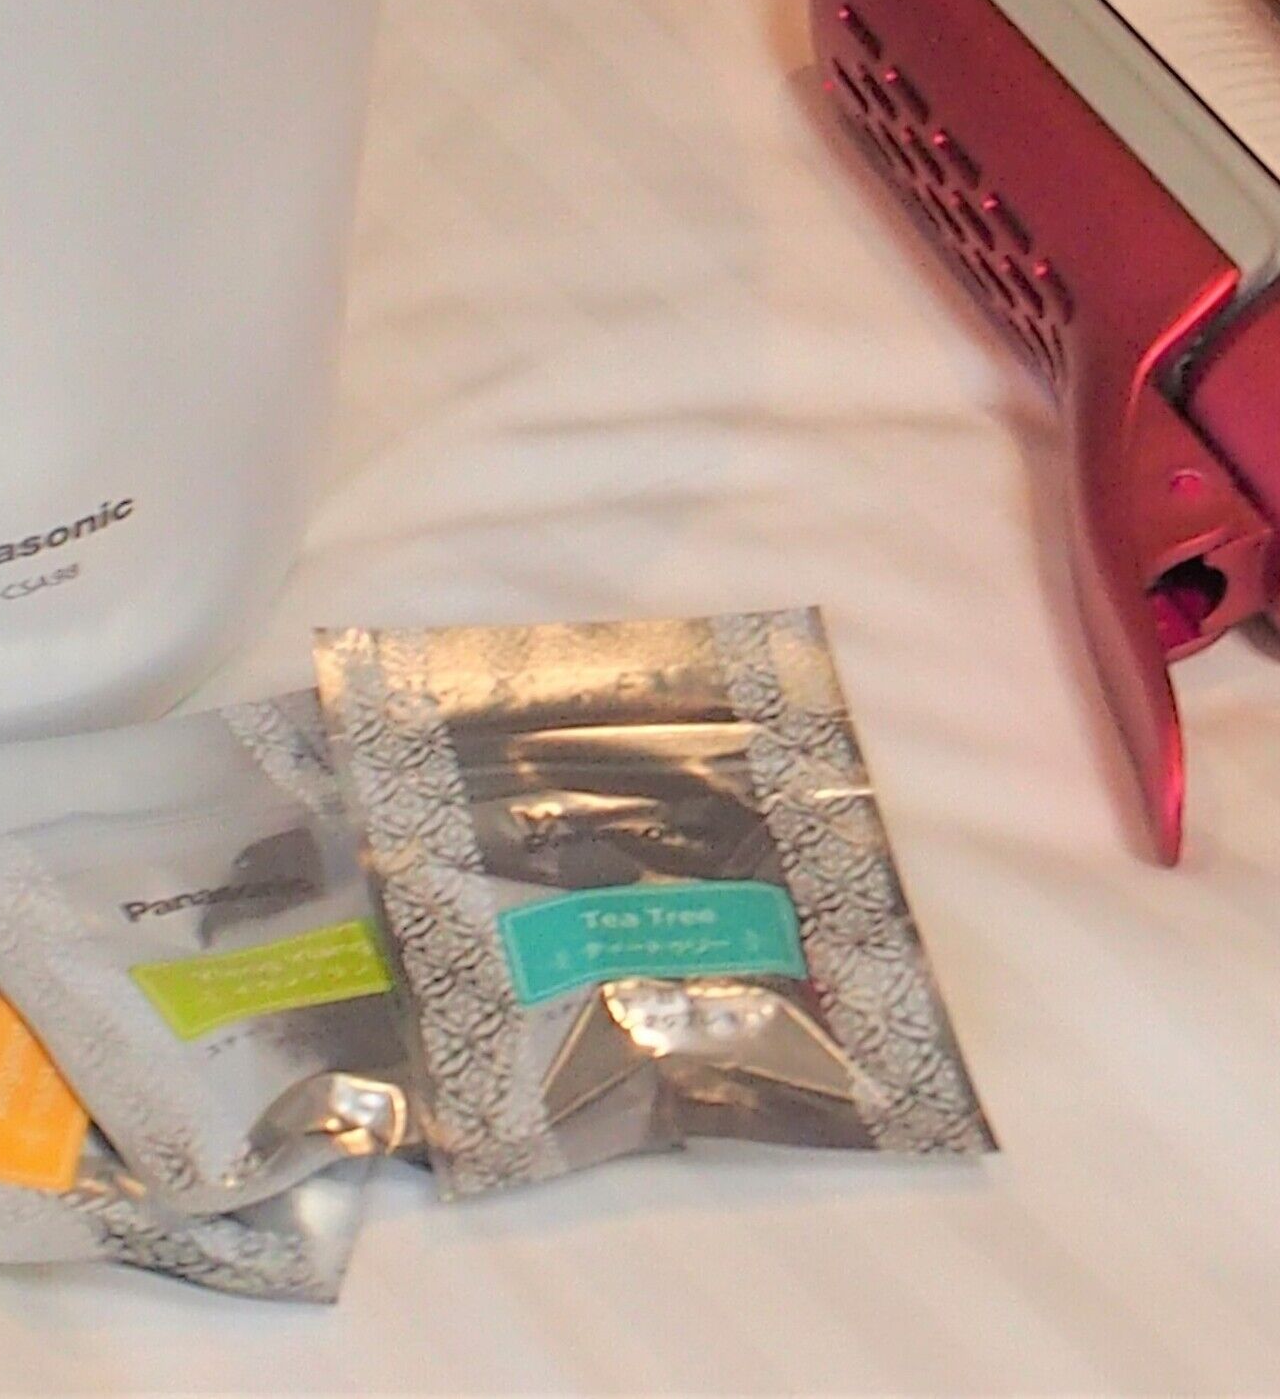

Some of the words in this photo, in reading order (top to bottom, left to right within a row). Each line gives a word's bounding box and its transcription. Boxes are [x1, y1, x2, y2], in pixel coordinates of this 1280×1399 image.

[121, 877, 318, 923] Panas
[579, 909, 640, 930] Tea
[646, 906, 717, 927] Tree
